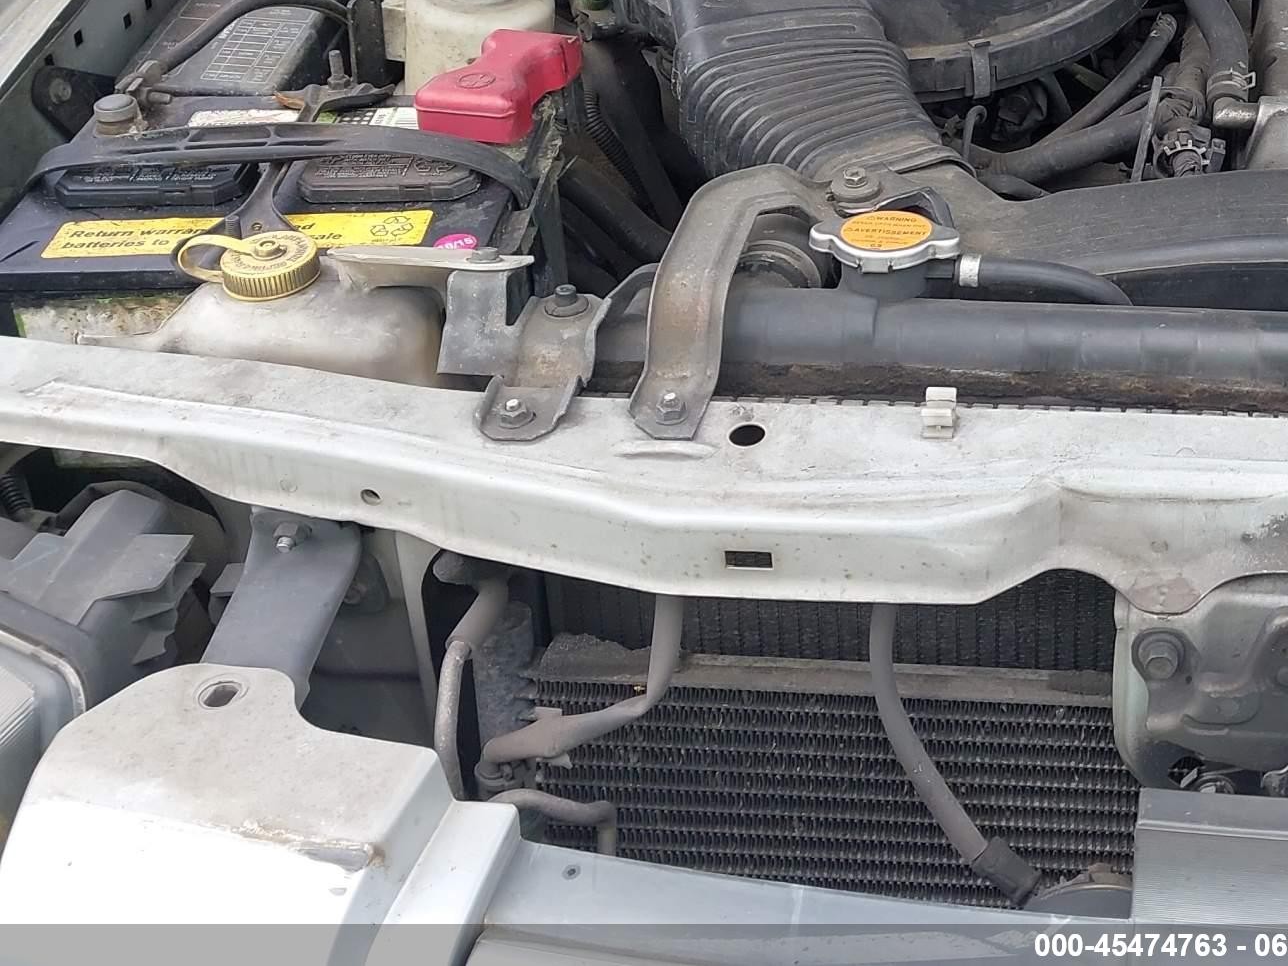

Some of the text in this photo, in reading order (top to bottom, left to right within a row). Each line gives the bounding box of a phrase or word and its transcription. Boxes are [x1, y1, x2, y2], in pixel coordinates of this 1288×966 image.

[70, 230, 133, 238] Return
[853, 227, 928, 235] AVERTISSEMENT
[62, 238, 145, 249] batteries
[152, 238, 169, 246] to
